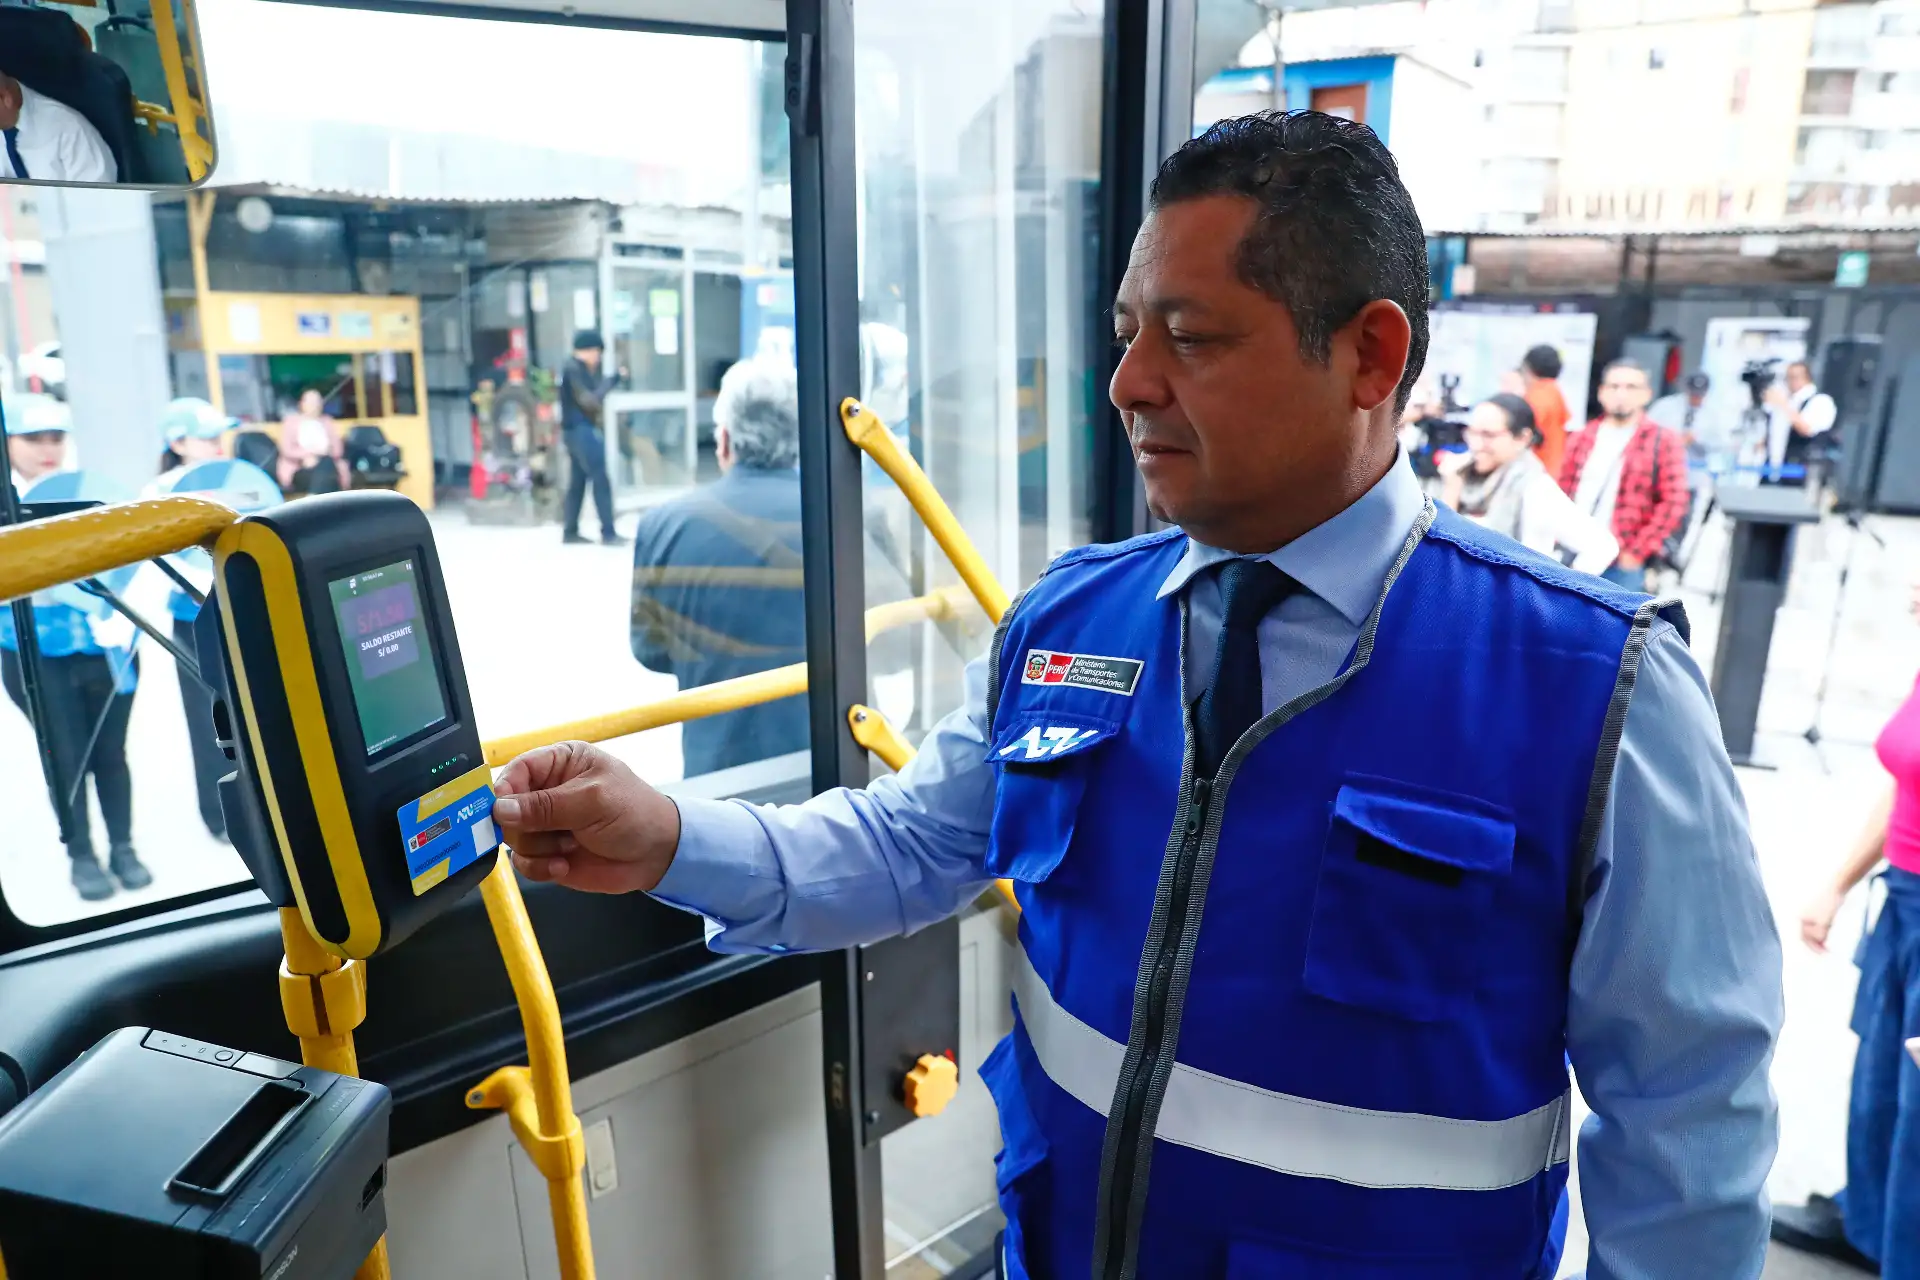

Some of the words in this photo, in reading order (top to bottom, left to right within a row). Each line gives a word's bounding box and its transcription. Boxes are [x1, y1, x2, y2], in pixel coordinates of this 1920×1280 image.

[361, 636, 382, 650] SALDO
[382, 625, 412, 643] RESTANTE
[385, 643, 399, 654] 0.00
[1048, 664, 1071, 674] PERÚ
[1075, 659, 1105, 669] Ministerio
[1079, 668, 1117, 679] Transportes
[457, 803, 474, 823] ATU
